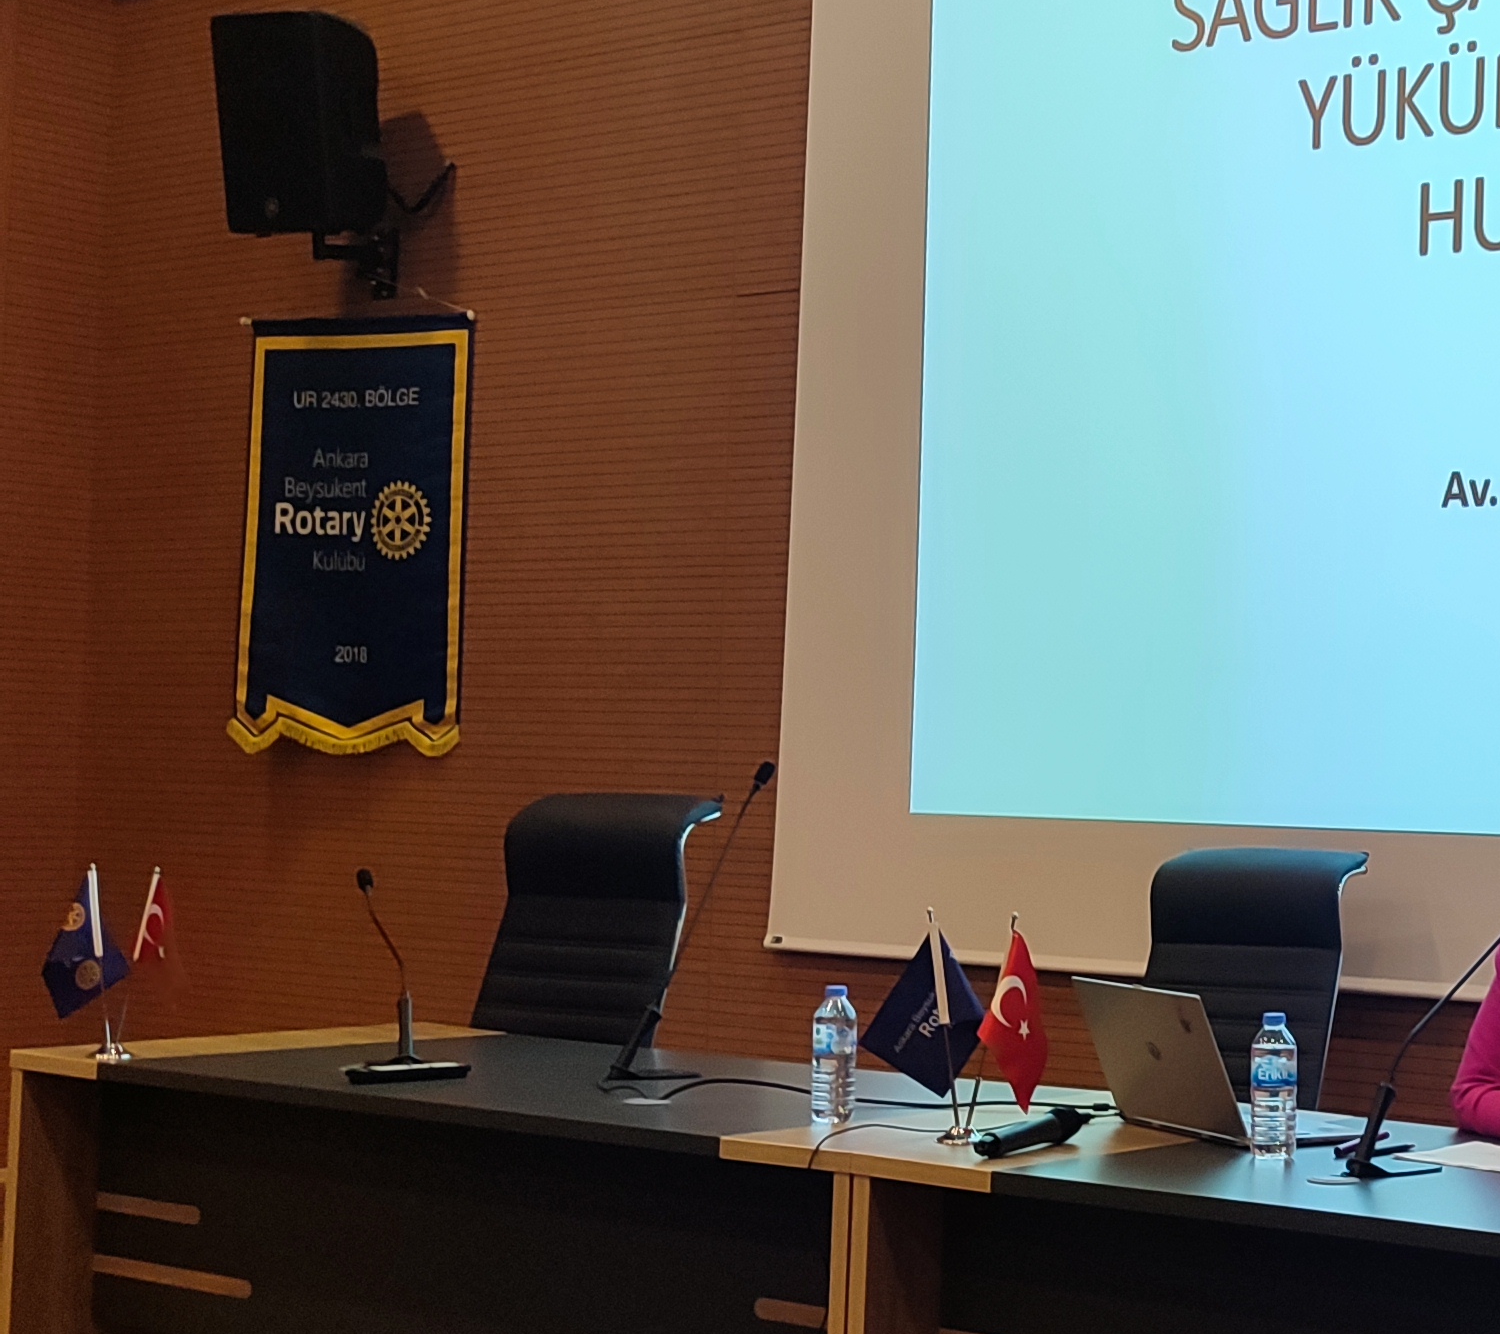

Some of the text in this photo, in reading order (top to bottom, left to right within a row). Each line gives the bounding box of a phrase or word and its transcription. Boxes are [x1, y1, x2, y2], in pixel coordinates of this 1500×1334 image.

[293, 385, 421, 409] UR 2430. BÖLGE
[312, 447, 369, 469] Ankara
[284, 476, 367, 505] Beysukent
[1441, 470, 1498, 508] Av.
[274, 502, 366, 543] Rotary
[312, 549, 366, 572] Kulübü
[334, 645, 368, 665] 2018
